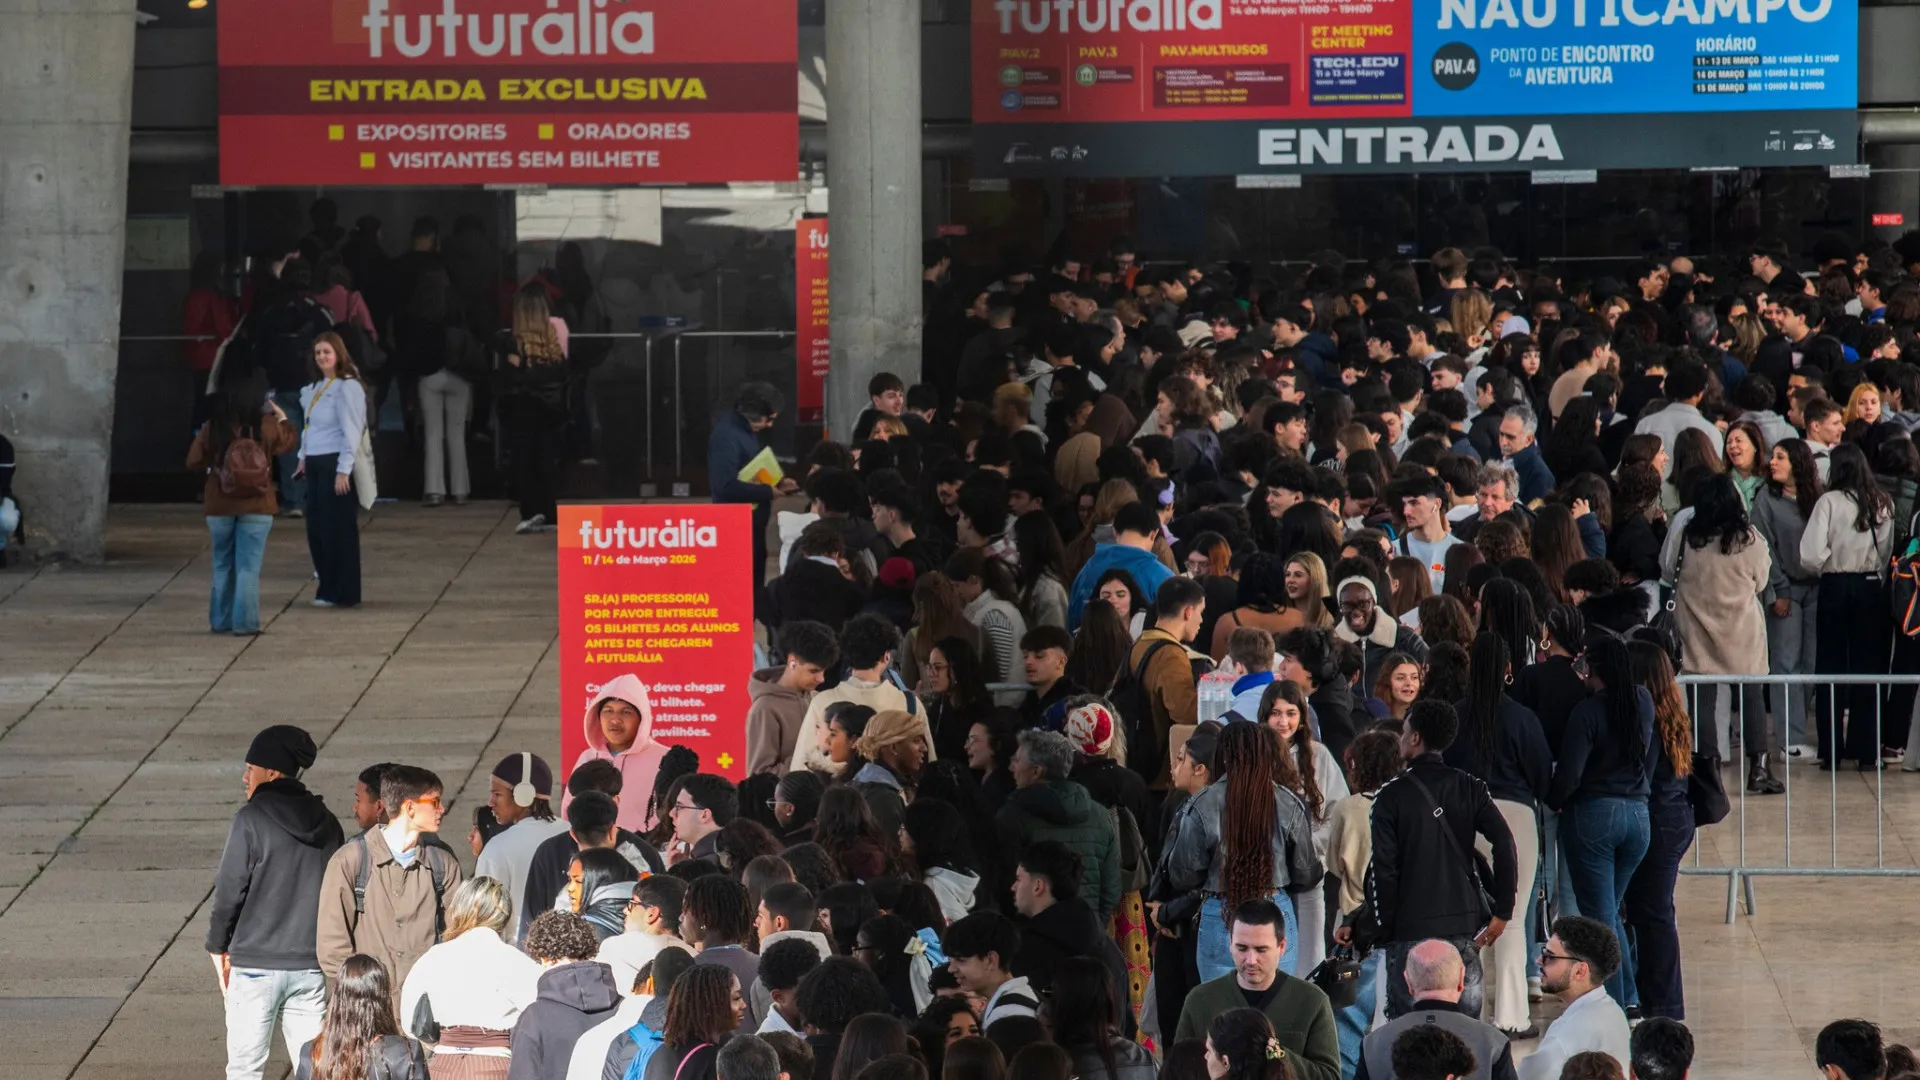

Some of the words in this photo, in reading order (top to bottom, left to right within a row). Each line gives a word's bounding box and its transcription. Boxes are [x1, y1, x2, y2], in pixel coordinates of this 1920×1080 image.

[1244, 5, 1259, 15] de
[1437, 0, 1832, 29] NAUTICAMPO
[1311, 25, 1329, 37] PT
[1332, 24, 1393, 36] MEETING
[1311, 37, 1366, 49] CENTER
[1696, 34, 1756, 52] HORÁRIO
[1080, 46, 1117, 58] PAV.3
[1160, 44, 1268, 56] PAV.MULTIUSOS
[1490, 48, 1537, 63] PONTO
[1541, 47, 1558, 62] DE
[1562, 44, 1654, 64] ENCONTRO
[1313, 56, 1399, 68] TECH.EDU
[1434, 58, 1476, 75] PAV.4
[1722, 57, 1731, 65] DE
[1733, 56, 1760, 66] MARÇO
[1762, 56, 1776, 64] DAS
[1343, 69, 1355, 77] de
[1357, 69, 1385, 79] Março
[1509, 68, 1522, 78] DA
[1525, 66, 1613, 85] AVENTURA
[1707, 70, 1717, 79] DE
[1718, 69, 1745, 80] MARÇO
[1748, 69, 1761, 78] DAS
[309, 79, 486, 101] ENTRADA
[499, 78, 708, 101] EXCLUSIVA
[1707, 83, 1717, 92] DE
[1718, 83, 1745, 94] MARÇO
[1748, 83, 1761, 91] DAS
[357, 123, 507, 141] EXPOSITORES
[568, 123, 691, 140] ORADORES
[1258, 124, 1564, 164] ENTRADA
[388, 152, 512, 169] VISITANTES
[519, 151, 564, 168] SEM
[570, 150, 660, 168] BILHETE
[579, 518, 717, 549] futurália
[582, 555, 592, 565] 11
[594, 554, 600, 566] /
[601, 555, 614, 565] 14
[616, 555, 630, 565] de
[633, 555, 667, 567] Março
[669, 554, 697, 565] 2026
[584, 594, 620, 606] SR.(A)
[622, 592, 709, 605] PROFESSOR(A)
[584, 609, 610, 619] POR
[613, 608, 653, 618] FAVOR
[656, 607, 719, 618] ENTREGUE
[584, 624, 601, 634] OS
[604, 623, 660, 633] BILHETES
[662, 623, 688, 633] AOS
[690, 622, 740, 633] ALUNOS
[584, 638, 624, 648] ANTES
[626, 638, 643, 648] DE
[646, 637, 713, 648] CHEGAREM
[584, 651, 594, 663] À
[597, 651, 663, 663] FUTURÁLIA
[653, 682, 682, 693] deve
[684, 682, 725, 694] chegar
[660, 697, 705, 707] bilhete.
[656, 713, 698, 722] atrasos
[701, 713, 717, 722] no
[652, 726, 710, 738] pavilhões.
